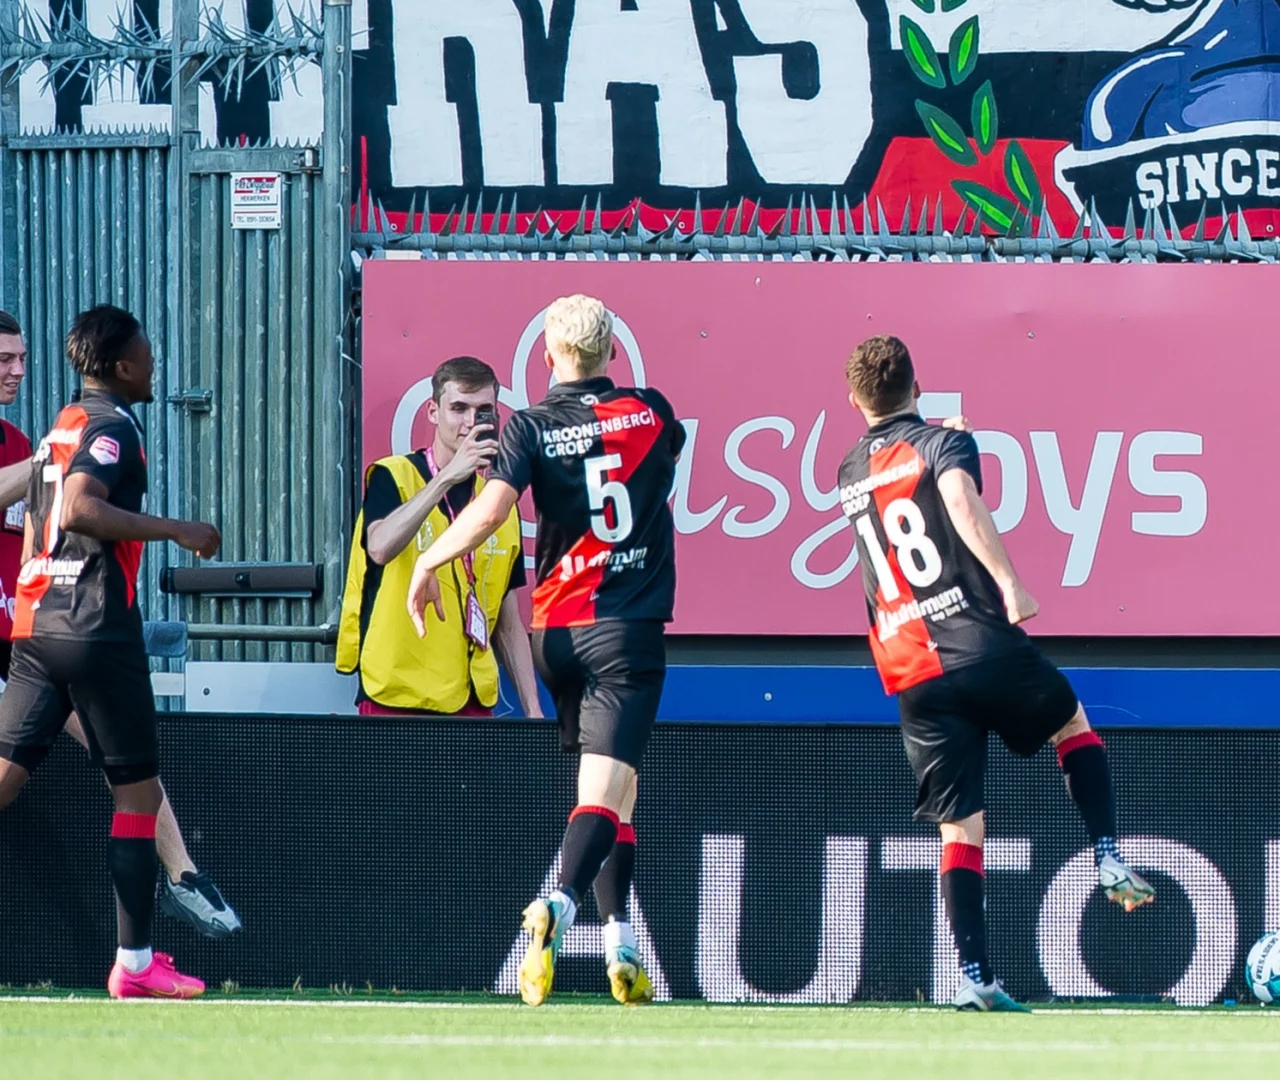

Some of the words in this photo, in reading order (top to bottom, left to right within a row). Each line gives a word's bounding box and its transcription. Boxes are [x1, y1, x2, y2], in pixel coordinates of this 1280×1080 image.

[543, 409, 652, 444] KROONENBERG
[545, 438, 593, 458] GROEP
[584, 452, 634, 543] 5
[855, 498, 943, 604] 18
